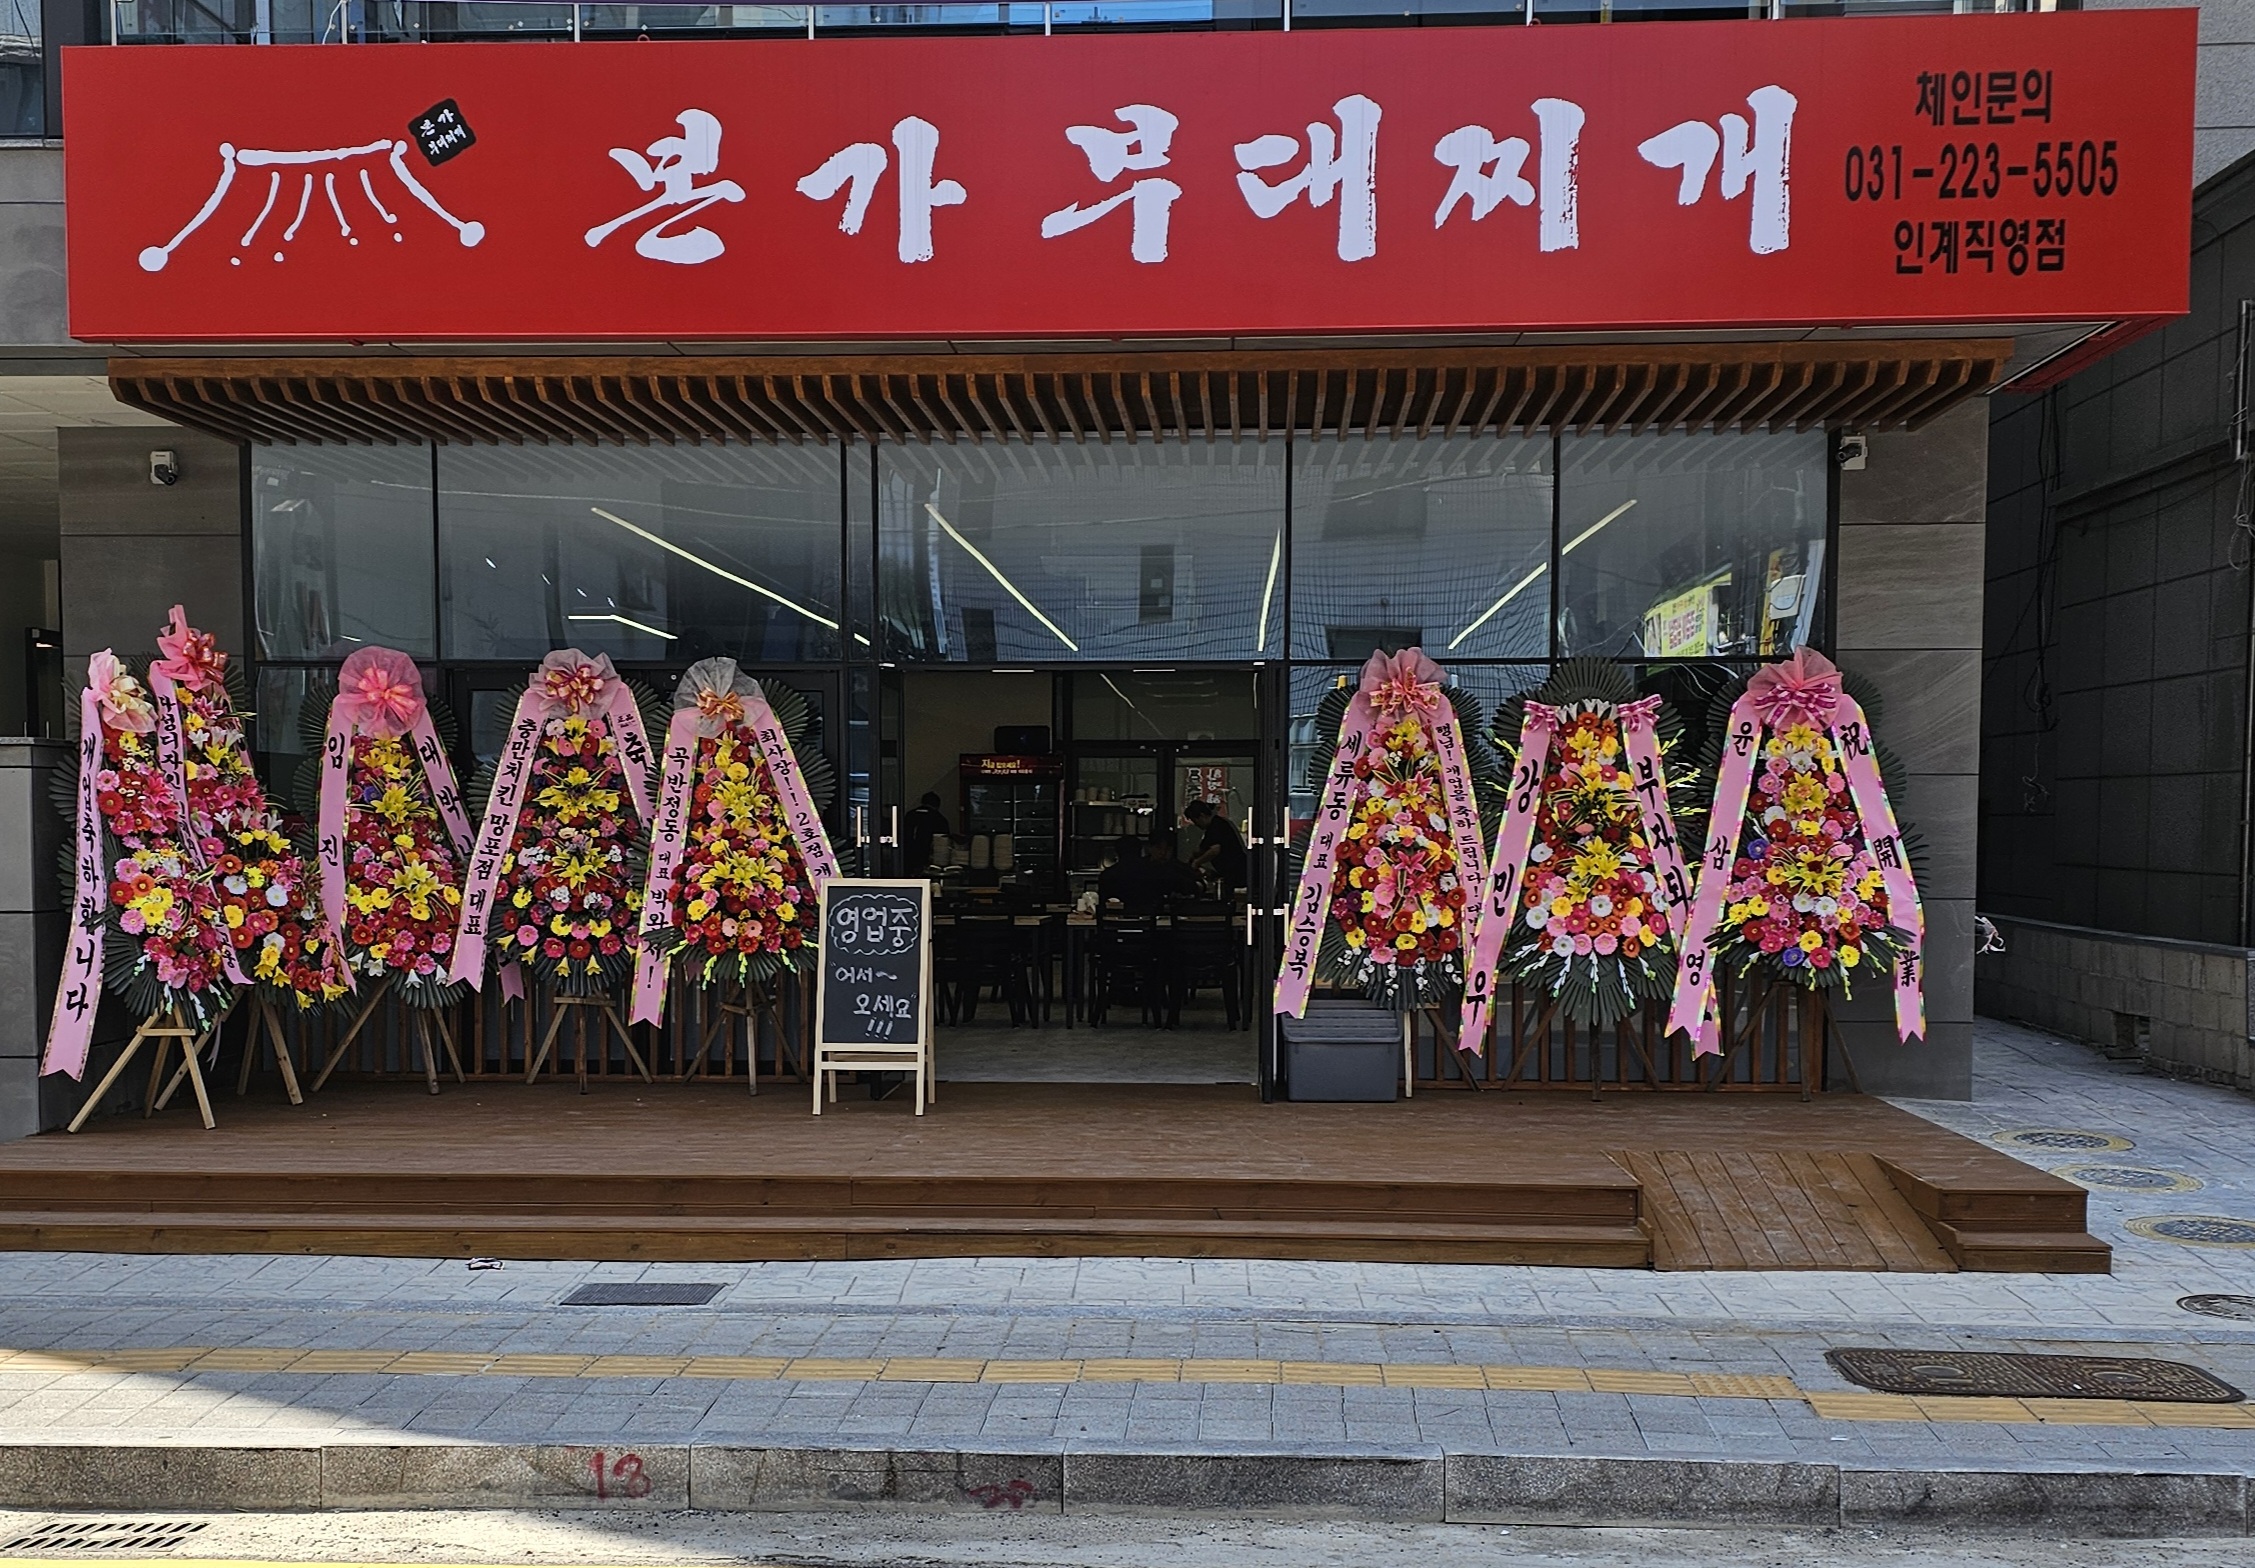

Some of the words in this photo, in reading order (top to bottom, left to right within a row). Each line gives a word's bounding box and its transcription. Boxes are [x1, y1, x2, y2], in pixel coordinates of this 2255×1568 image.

[1916, 69, 2053, 127] 체인문의
[1844, 140, 2119, 202] 031-223-5505
[1893, 218, 2067, 276] 인계직영점
[496, 718, 537, 808] 충만치킨
[1325, 730, 1363, 821] 세류동
[658, 747, 690, 843] 곡반정동
[474, 813, 511, 883] 망포점
[796, 812, 824, 859] 2호점
[1312, 832, 1335, 870] 대표
[655, 850, 672, 880] 대표
[463, 893, 488, 936] 대표
[836, 907, 914, 948] 영업중
[1288, 882, 1323, 981] 김승복
